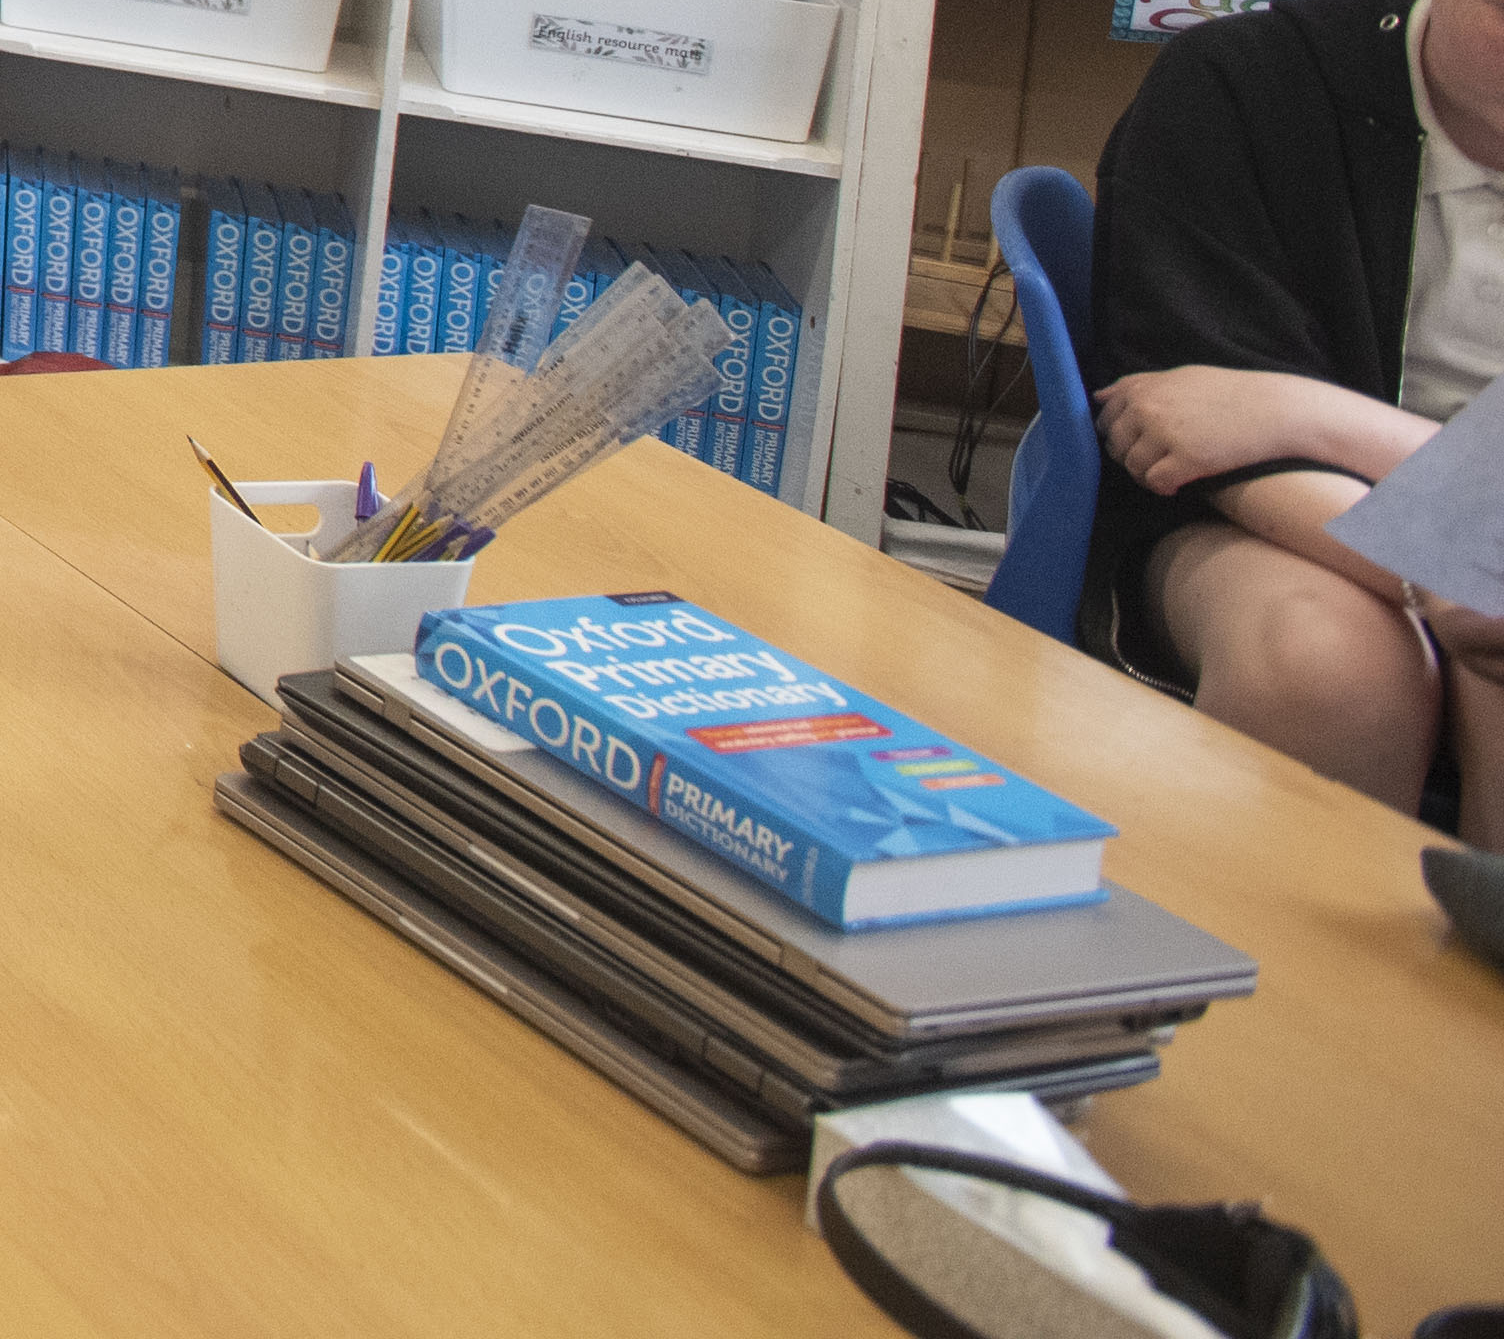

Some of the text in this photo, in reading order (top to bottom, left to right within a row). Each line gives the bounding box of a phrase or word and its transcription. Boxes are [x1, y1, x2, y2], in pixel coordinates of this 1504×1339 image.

[10, 190, 36, 286] OXFORD
[45, 195, 71, 292] OXFORD
[78, 202, 104, 300] OXFORD
[111, 207, 138, 304] OXFORD
[146, 212, 174, 309] OXFORD
[495, 609, 737, 659] Oxford
[547, 647, 797, 693] Primary
[604, 681, 849, 720] Dictionary
[433, 640, 794, 864] OXFORD PRIMARY
[663, 797, 789, 883] DICTIONARY
